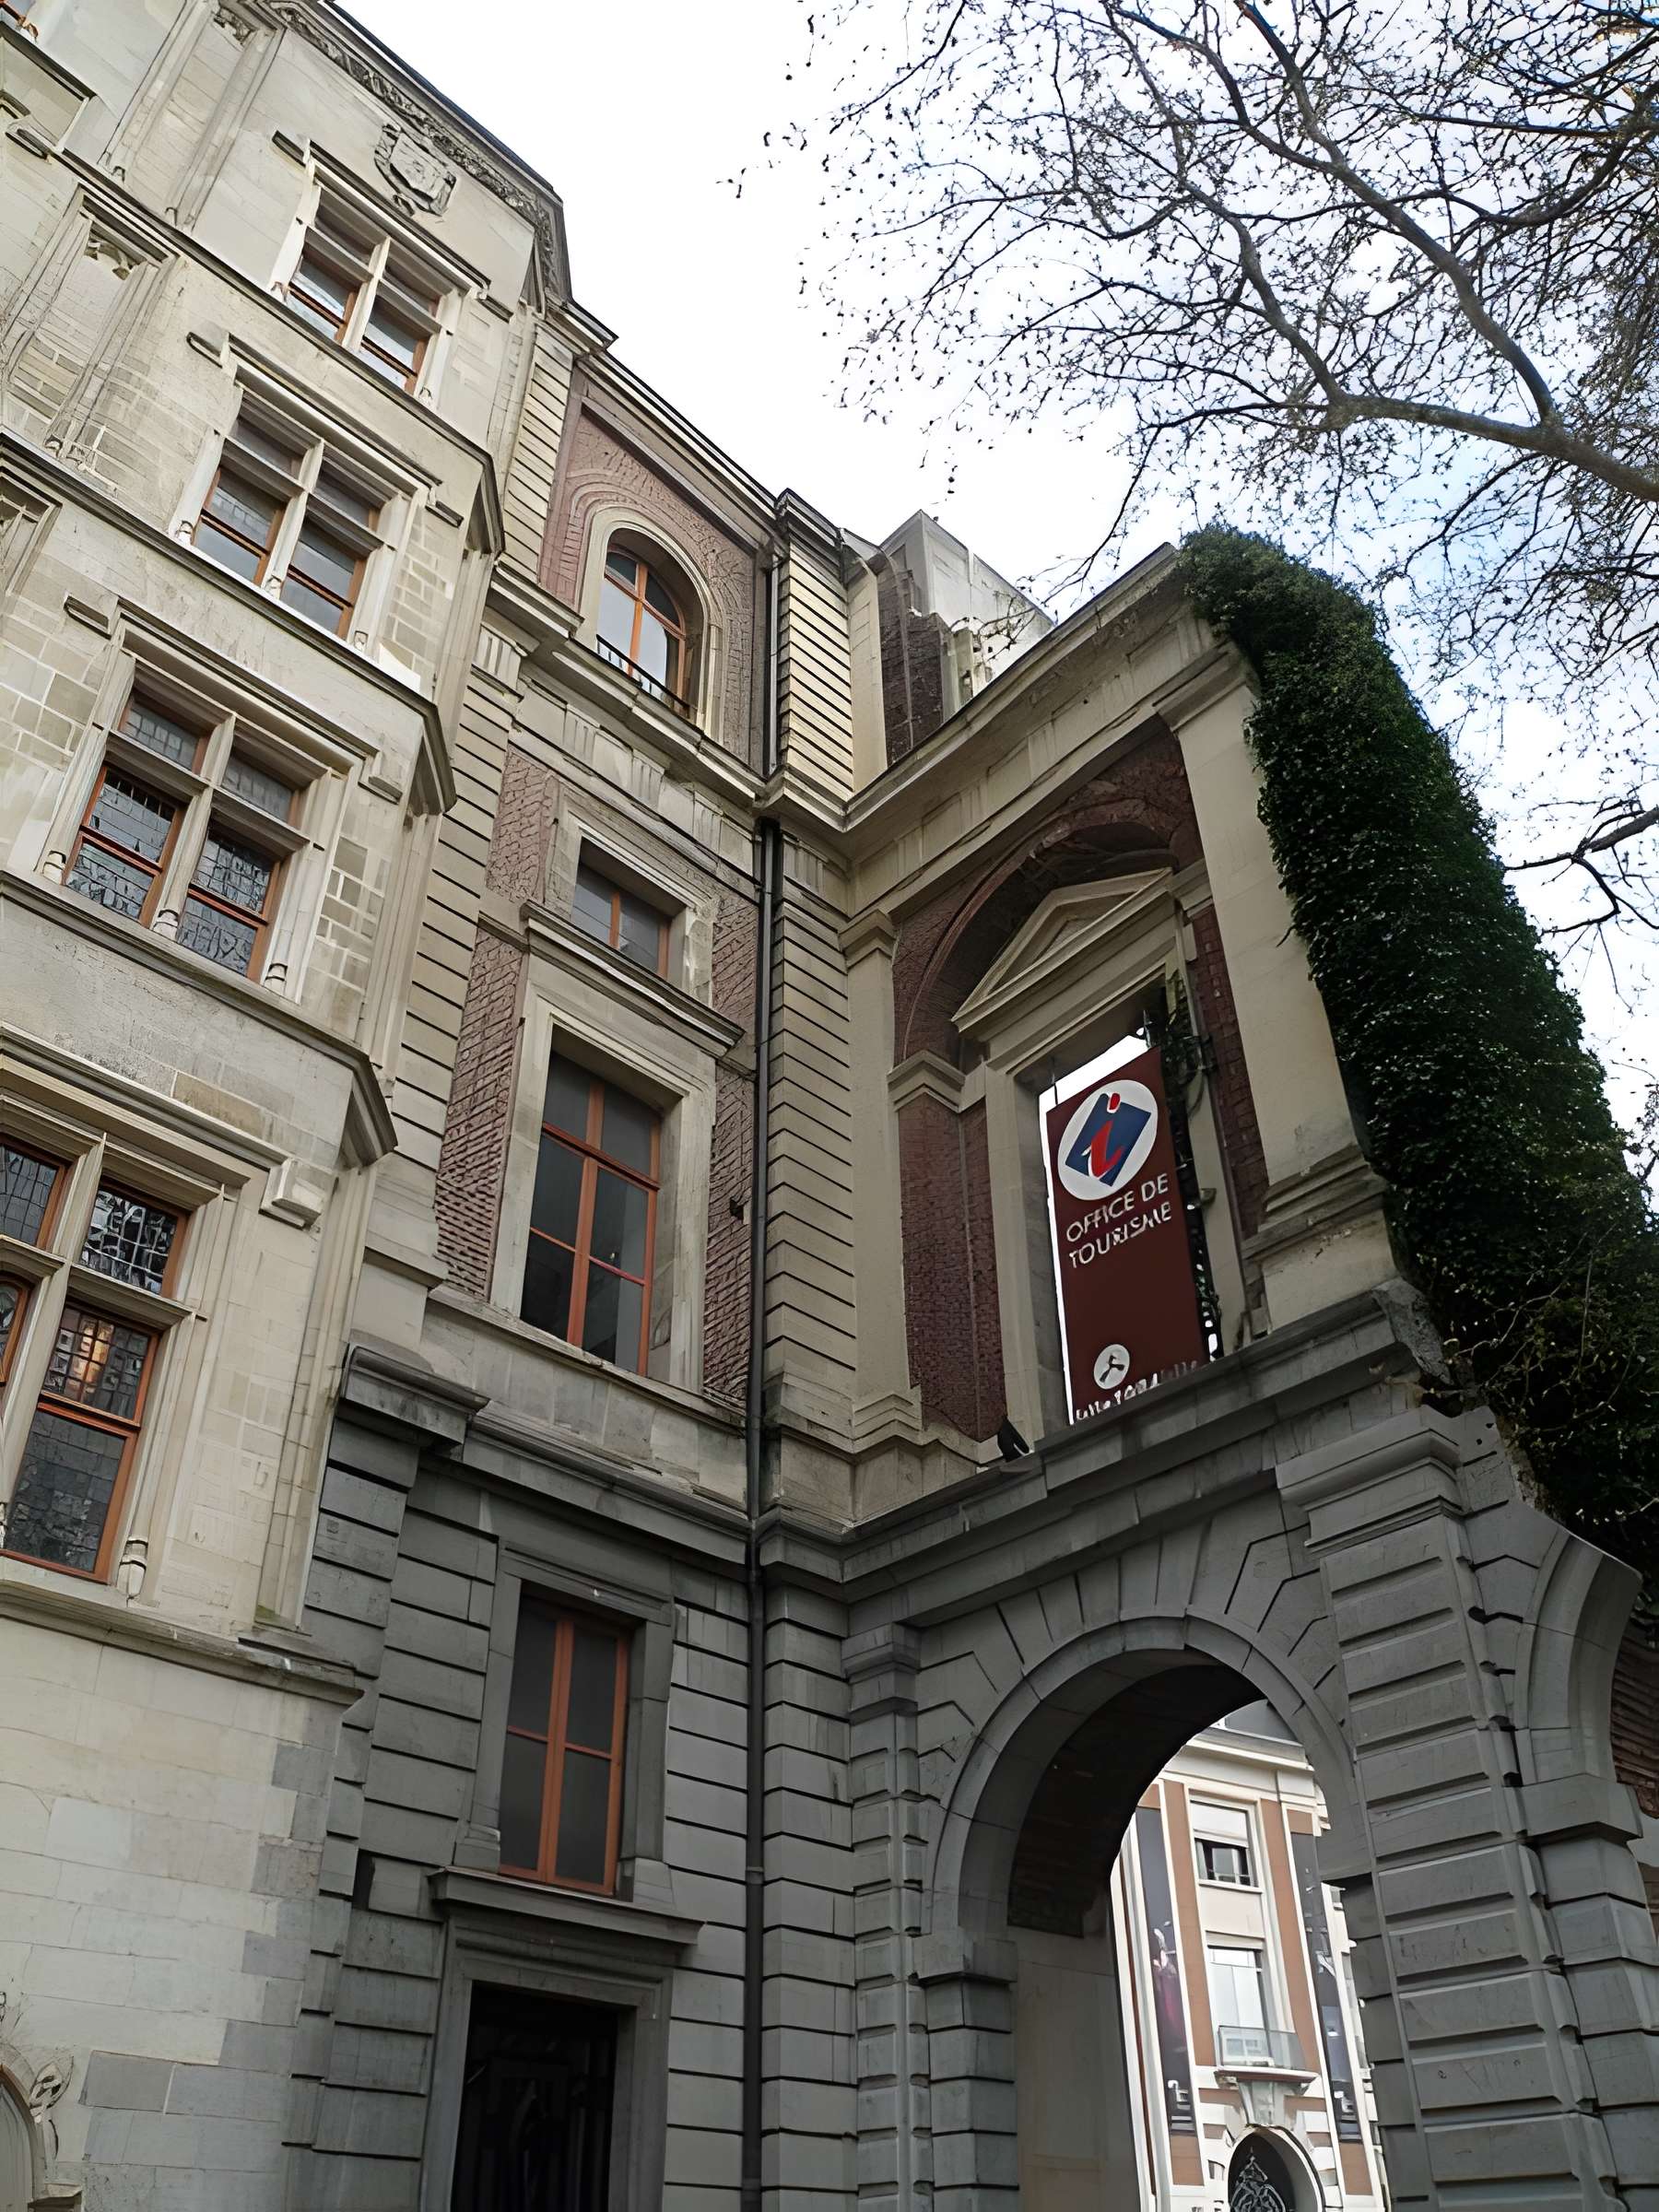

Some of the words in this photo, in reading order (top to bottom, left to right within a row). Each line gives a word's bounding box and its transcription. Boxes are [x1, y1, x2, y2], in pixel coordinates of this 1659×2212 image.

[1066, 1191, 1135, 1242] OFFICE
[1141, 1173, 1169, 1202] DE
[1069, 1202, 1171, 1268] TOURISME
